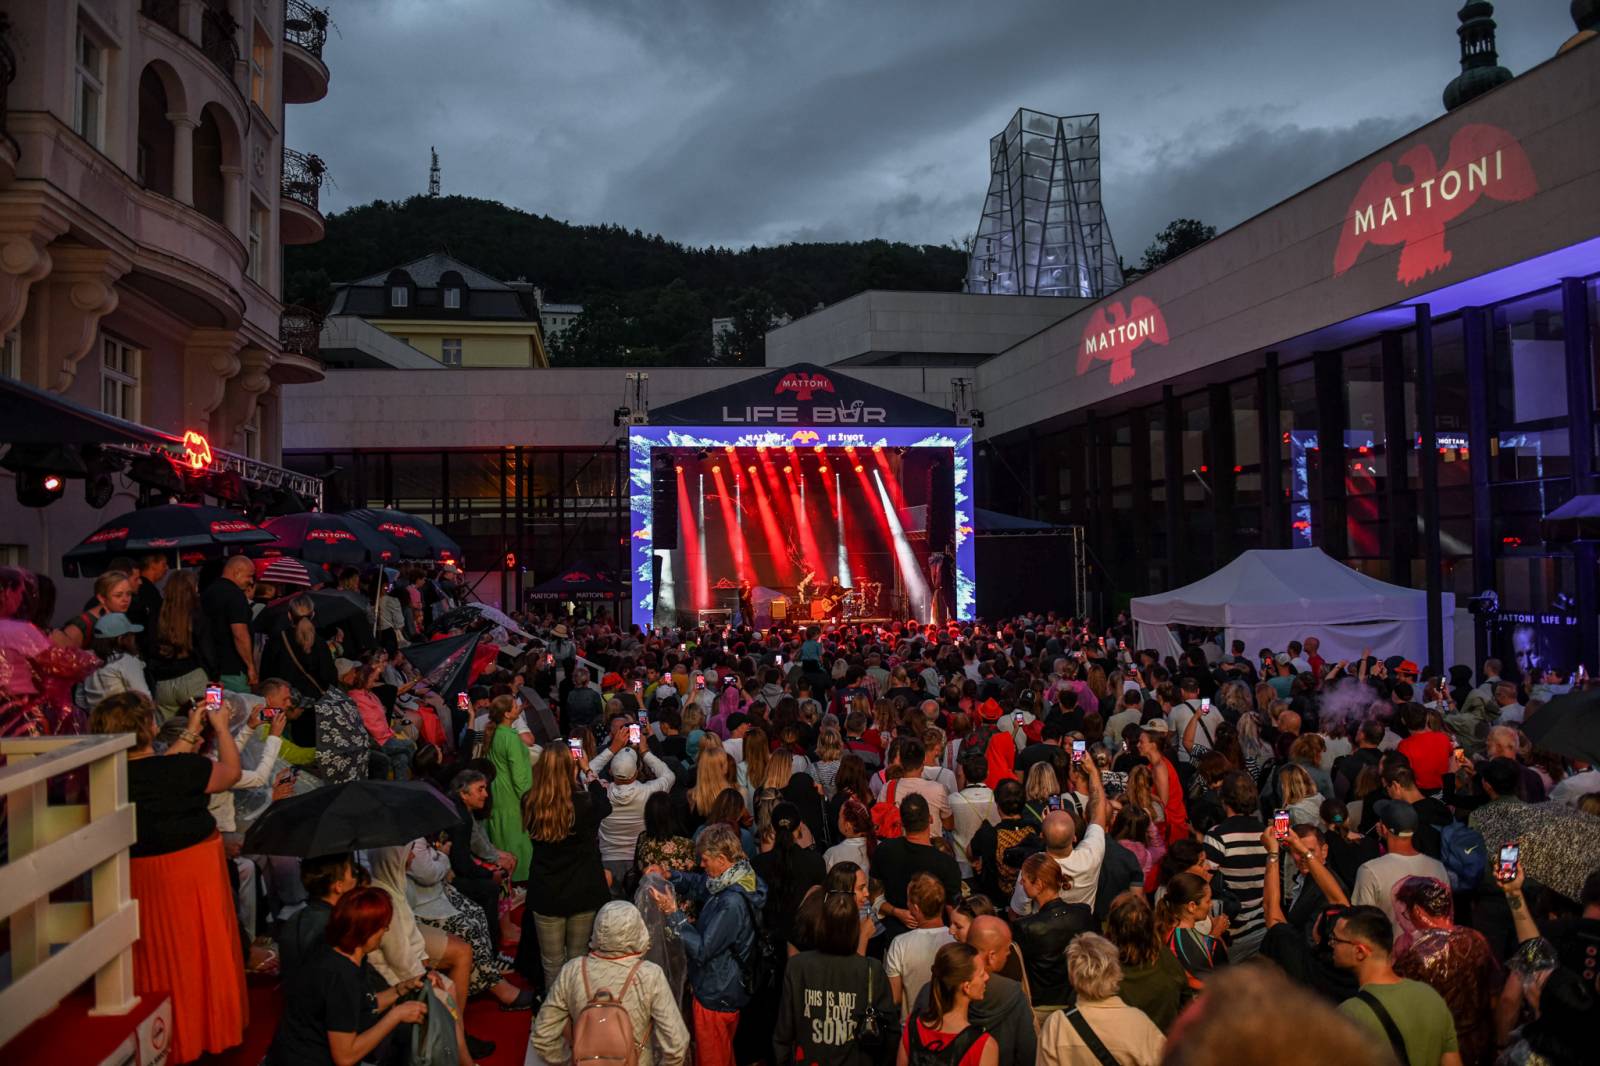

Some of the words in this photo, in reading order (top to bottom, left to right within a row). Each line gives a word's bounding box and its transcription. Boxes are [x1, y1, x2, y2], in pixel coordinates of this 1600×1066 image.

[1354, 149, 1502, 236] MATTONI
[1085, 315, 1155, 355] MATTONI
[782, 380, 829, 388] MATTONI
[722, 406, 799, 423] LIFE
[827, 434, 837, 442] JE
[838, 432, 864, 442] ŽIVOT
[383, 524, 417, 536] MATTONI
[1541, 615, 1560, 625] LIFE
[804, 988, 823, 1007] THIS
[826, 990, 835, 1007] IS
[838, 991, 857, 1010] NOT
[803, 1003, 811, 1019] A
[826, 1005, 853, 1022] LOVE
[812, 1018, 857, 1045] SONG
